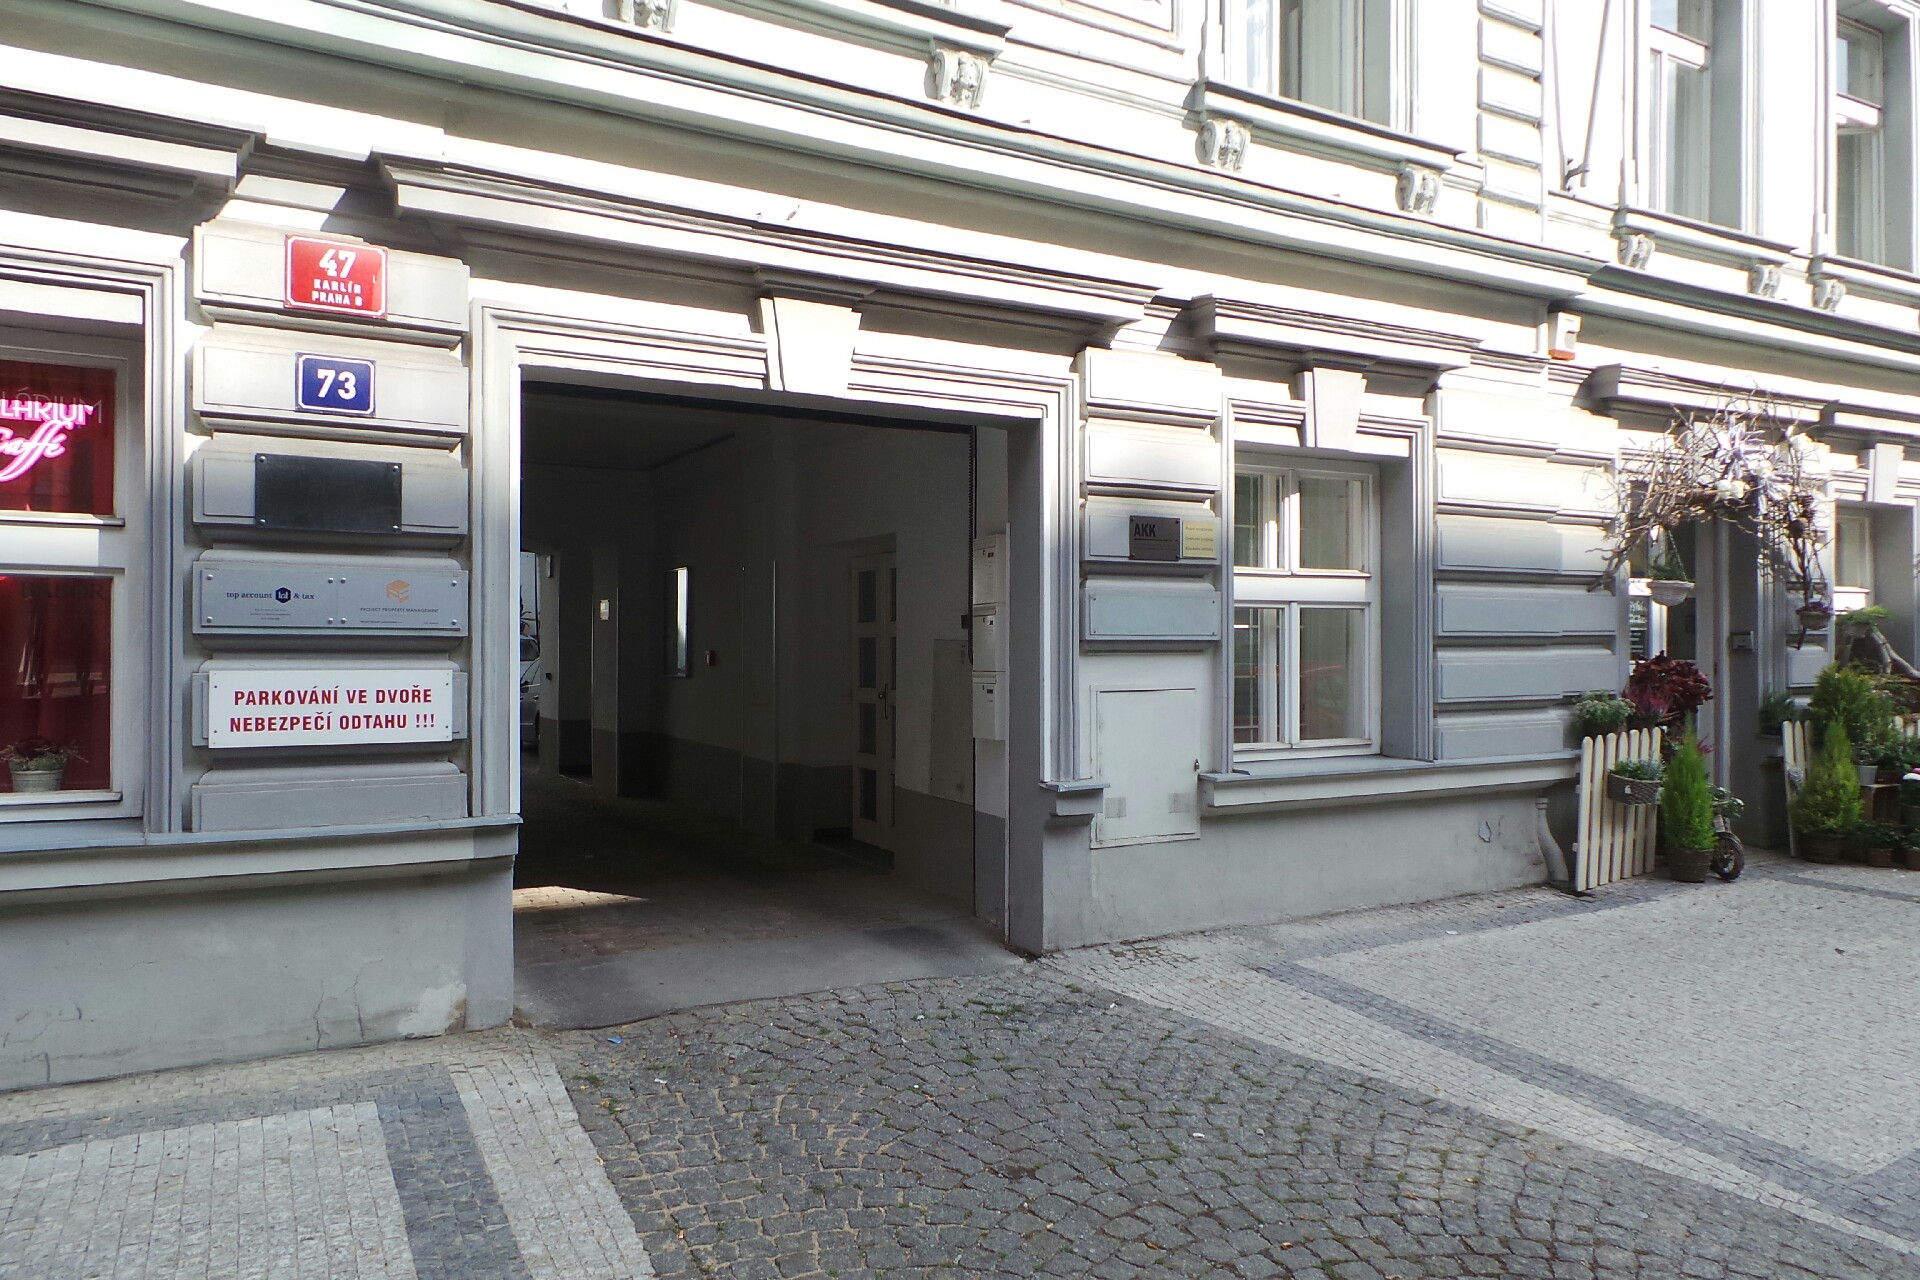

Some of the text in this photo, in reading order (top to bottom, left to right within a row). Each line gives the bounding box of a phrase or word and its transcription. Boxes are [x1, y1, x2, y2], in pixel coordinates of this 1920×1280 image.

[318, 248, 357, 278] 47
[313, 278, 361, 294] KARLÍN
[311, 290, 351, 306] PRAHA
[317, 368, 357, 400] 73
[1134, 523, 1156, 538] AKK
[226, 591, 240, 600] top
[241, 591, 273, 600] account
[293, 592, 300, 600] &
[302, 592, 316, 600] tax
[234, 684, 432, 706] PARKOVÁNÍ VE DVOŘE
[229, 711, 436, 732] NEBEZPEČÍ ODTAHU !!!
